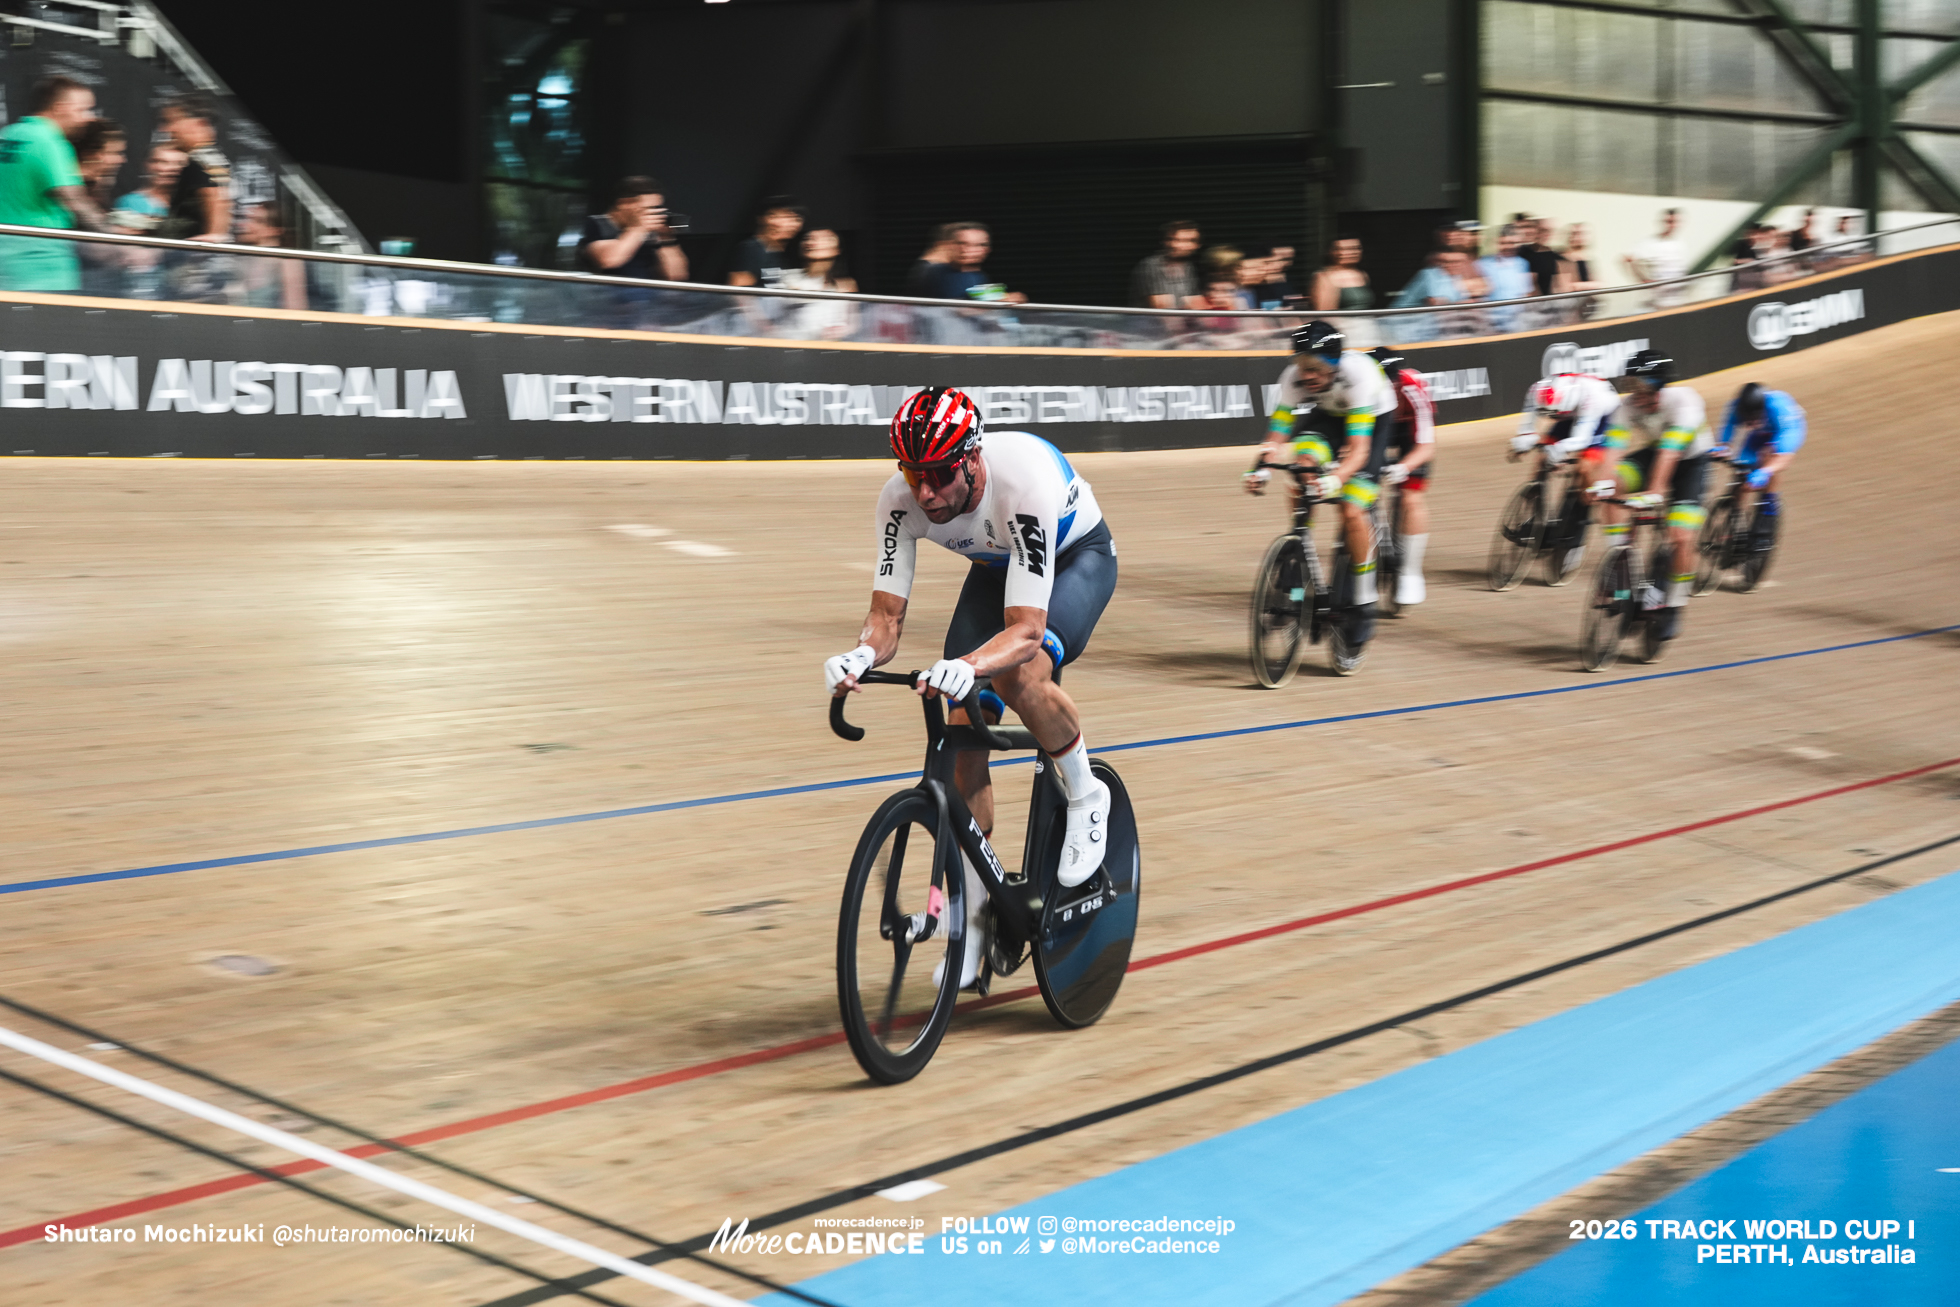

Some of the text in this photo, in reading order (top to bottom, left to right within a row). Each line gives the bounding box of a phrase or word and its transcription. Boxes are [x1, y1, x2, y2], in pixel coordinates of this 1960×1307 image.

[146, 358, 467, 420] AUSTRALIA
[503, 373, 724, 424] WESTERN
[957, 538, 974, 547] UEC
[1007, 520, 1017, 535] BIKE
[1015, 514, 1047, 578] KTM
